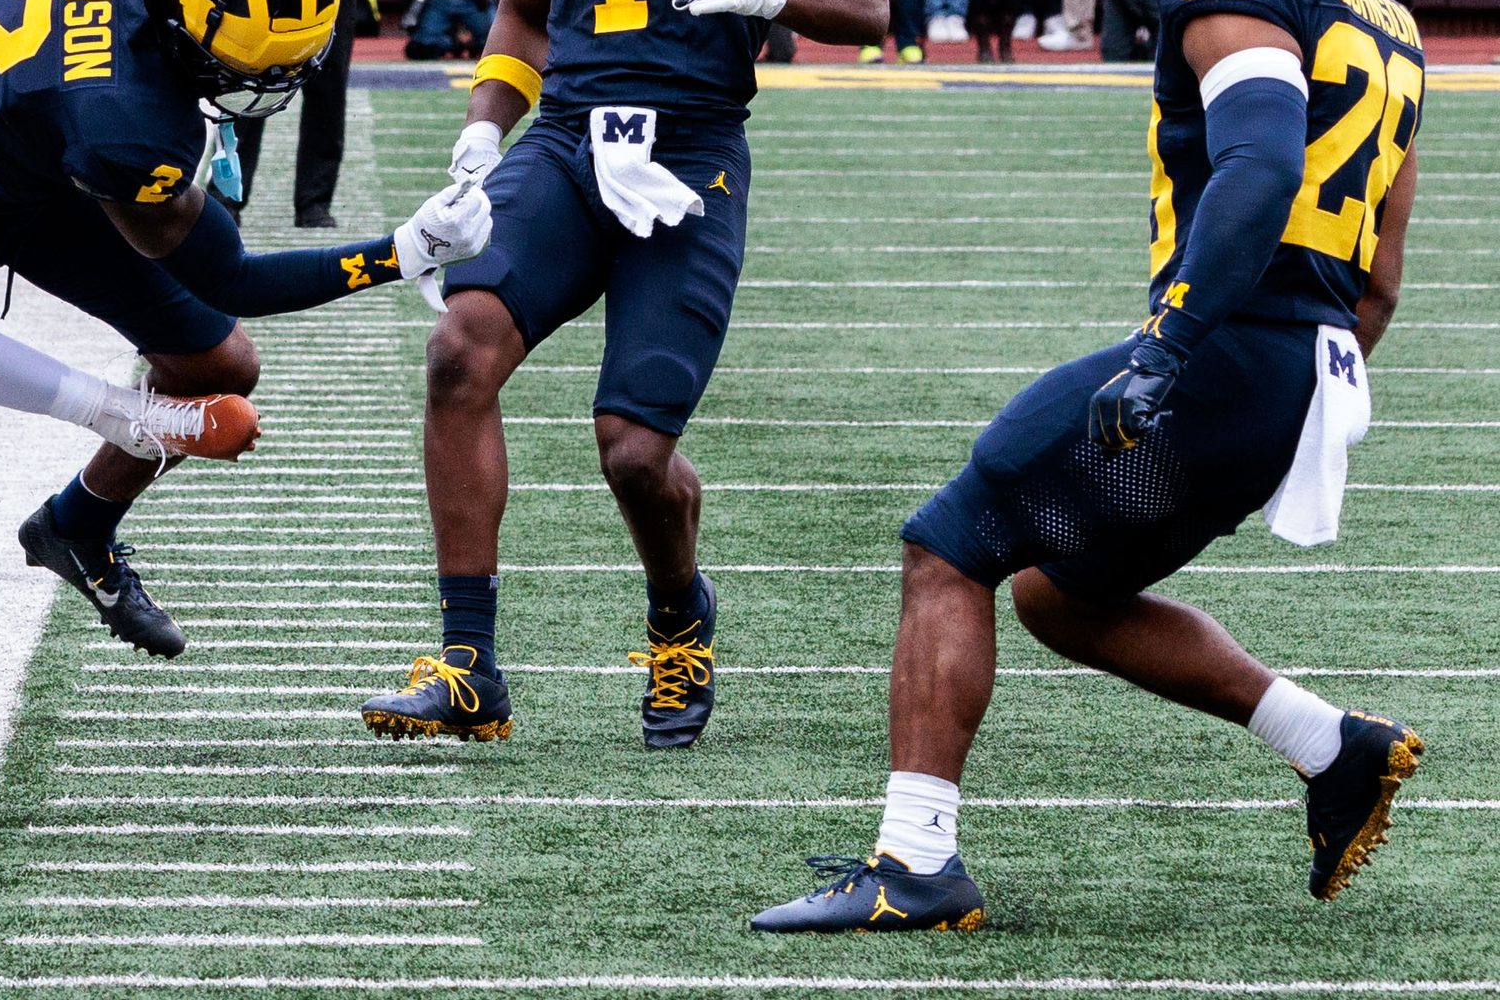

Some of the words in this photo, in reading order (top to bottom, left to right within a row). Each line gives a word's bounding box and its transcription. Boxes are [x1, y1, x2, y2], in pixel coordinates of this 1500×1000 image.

[602, 111, 647, 145] M
[1279, 21, 1423, 273] 28
[135, 164, 182, 203] 2
[340, 252, 372, 289] M
[1160, 281, 1191, 309] M
[1327, 338, 1358, 389] M
